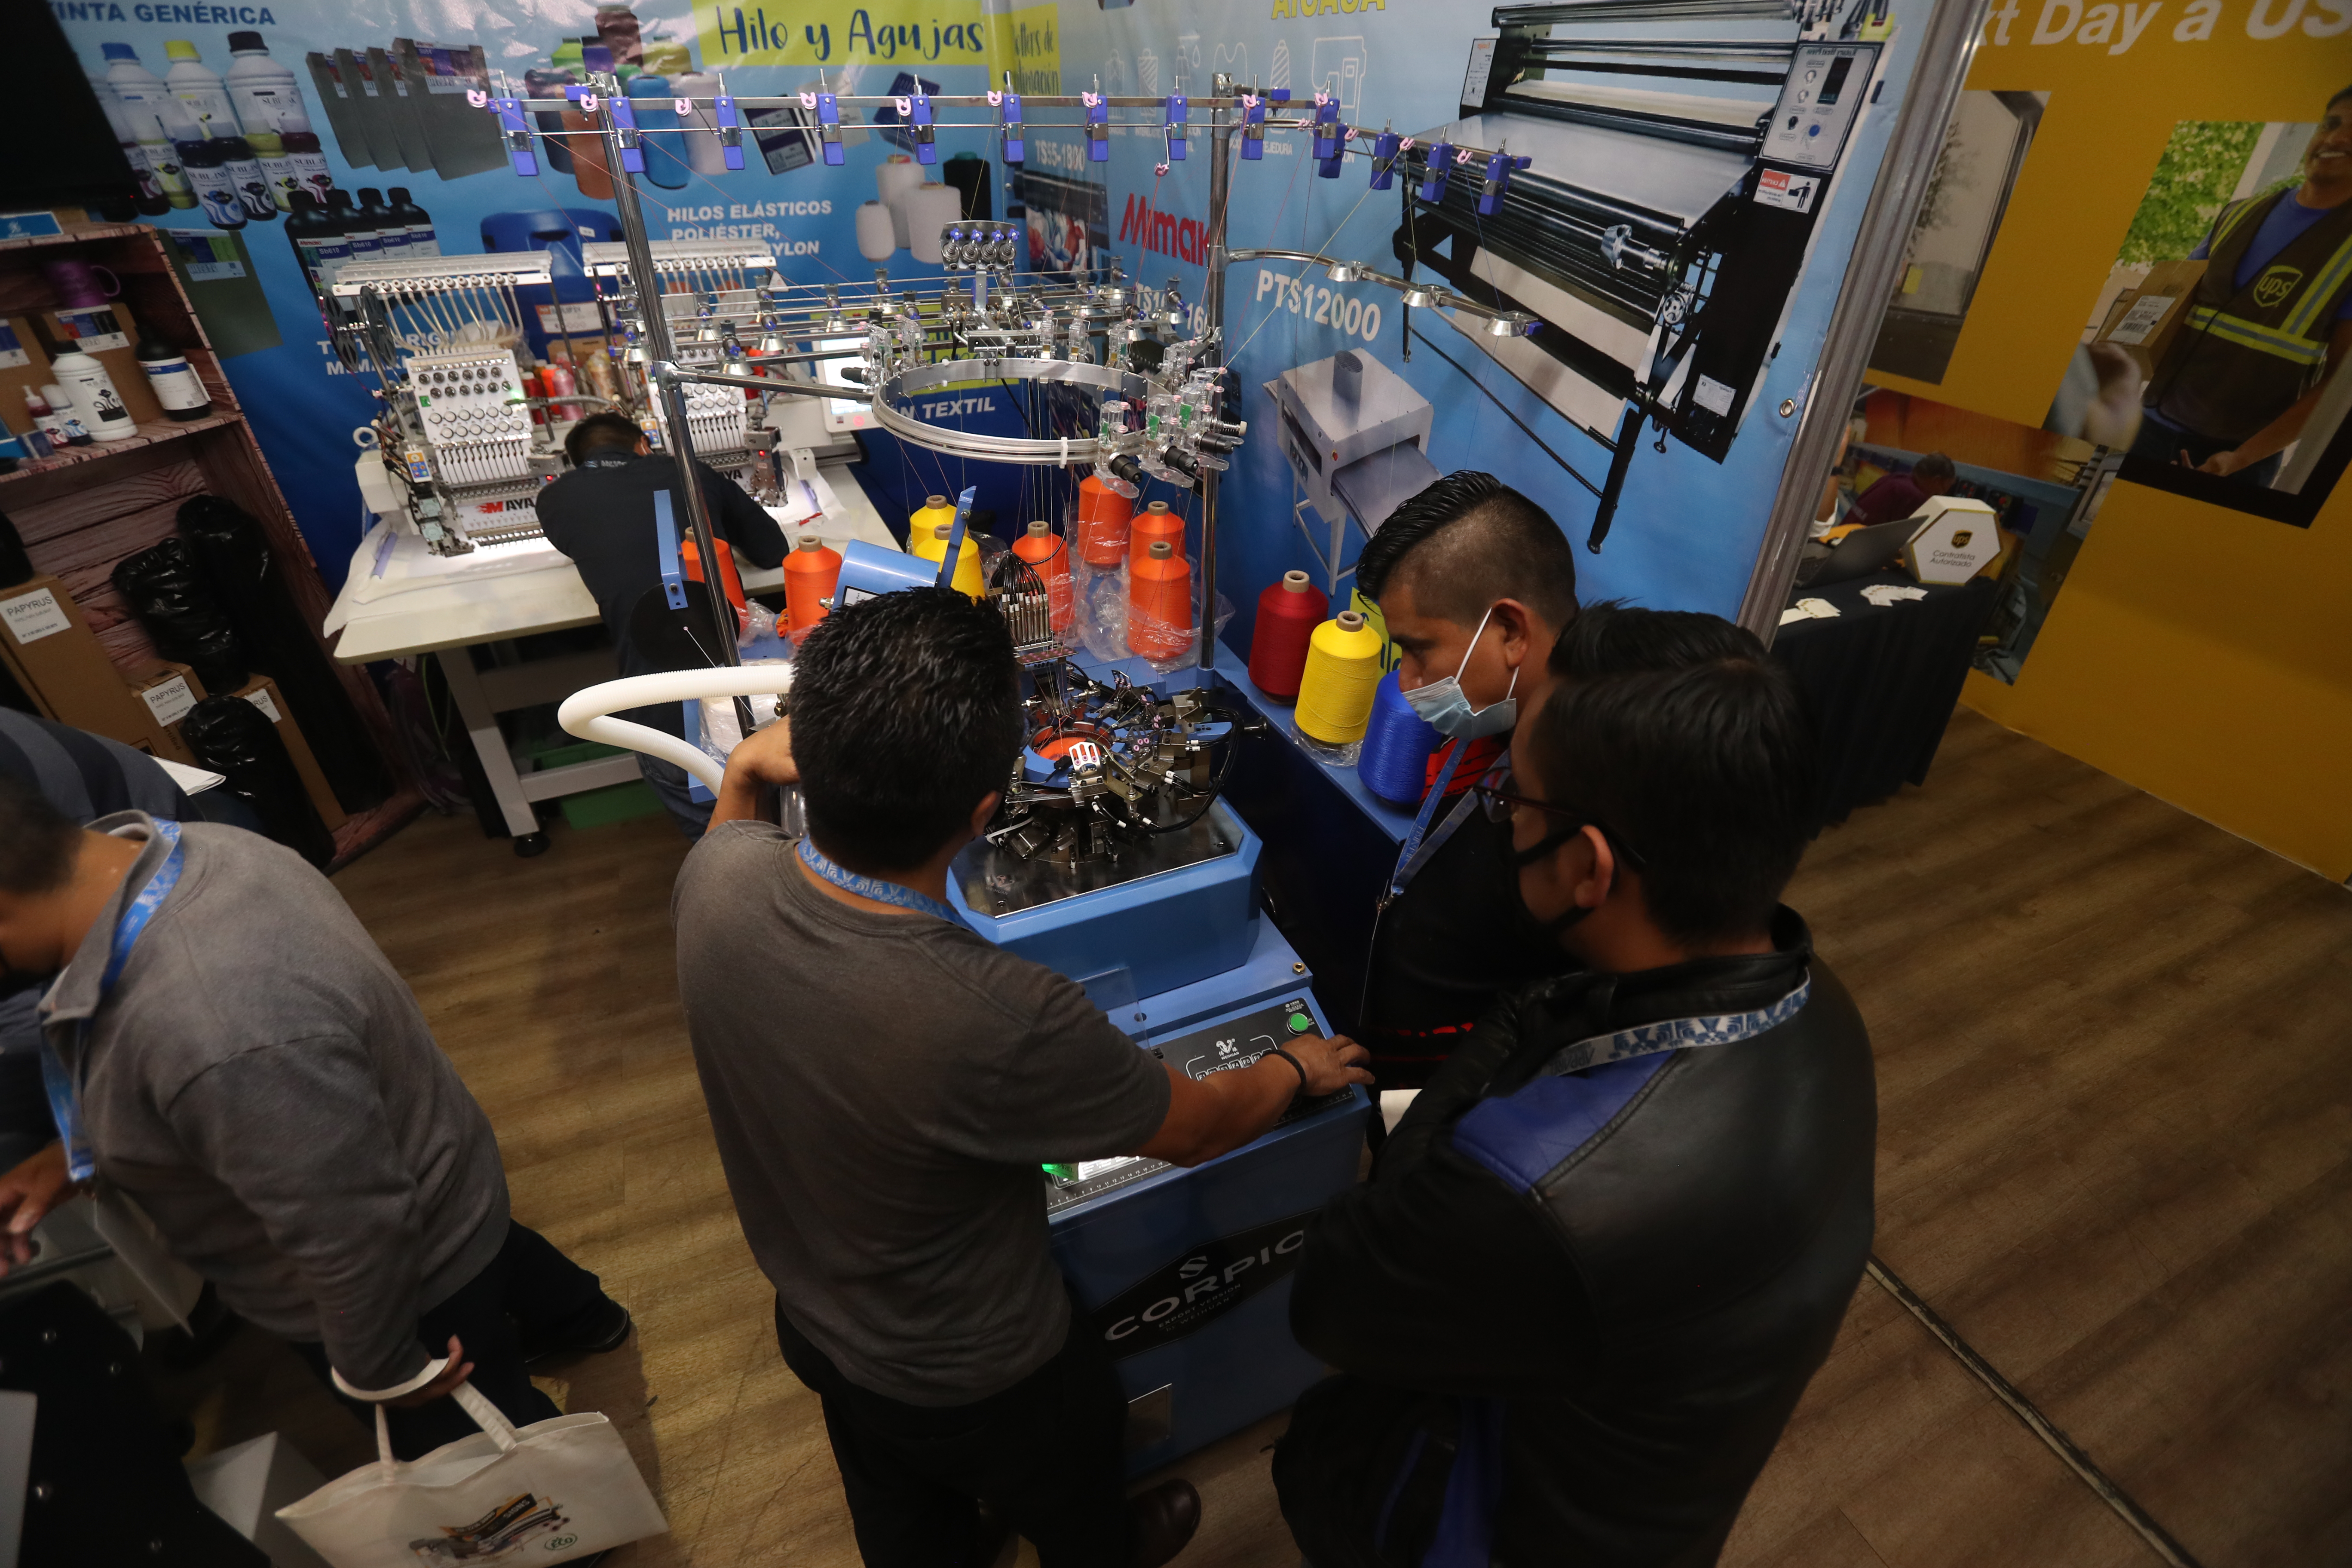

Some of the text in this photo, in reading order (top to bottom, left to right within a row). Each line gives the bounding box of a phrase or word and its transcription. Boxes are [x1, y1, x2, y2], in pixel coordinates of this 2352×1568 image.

[57, 1, 276, 25] INTA GENÉRICA
[717, 6, 984, 61] Hilo y Agujas
[2030, 0, 2153, 55] Day
[1035, 139, 1086, 172] TS55-1800
[667, 200, 832, 223] HILOS ELÁSTICOS
[770, 240, 819, 257] YLON
[2258, 276, 2293, 300] ups
[1256, 270, 1381, 342] PTS12000
[922, 397, 996, 419] TEXTIL
[1930, 557, 1972, 568] Autorizado
[1933, 550, 1976, 560] Contratista
[6, 596, 53, 616] PAPYRUS
[150, 683, 186, 704] PAPYRUS
[163, 726, 182, 751] ertified
[1221, 1051, 1240, 1060] WEIHUAN
[1158, 1283, 1241, 1328] EXPORT VERSION
[1180, 1297, 1230, 1324] WEIHUAN
